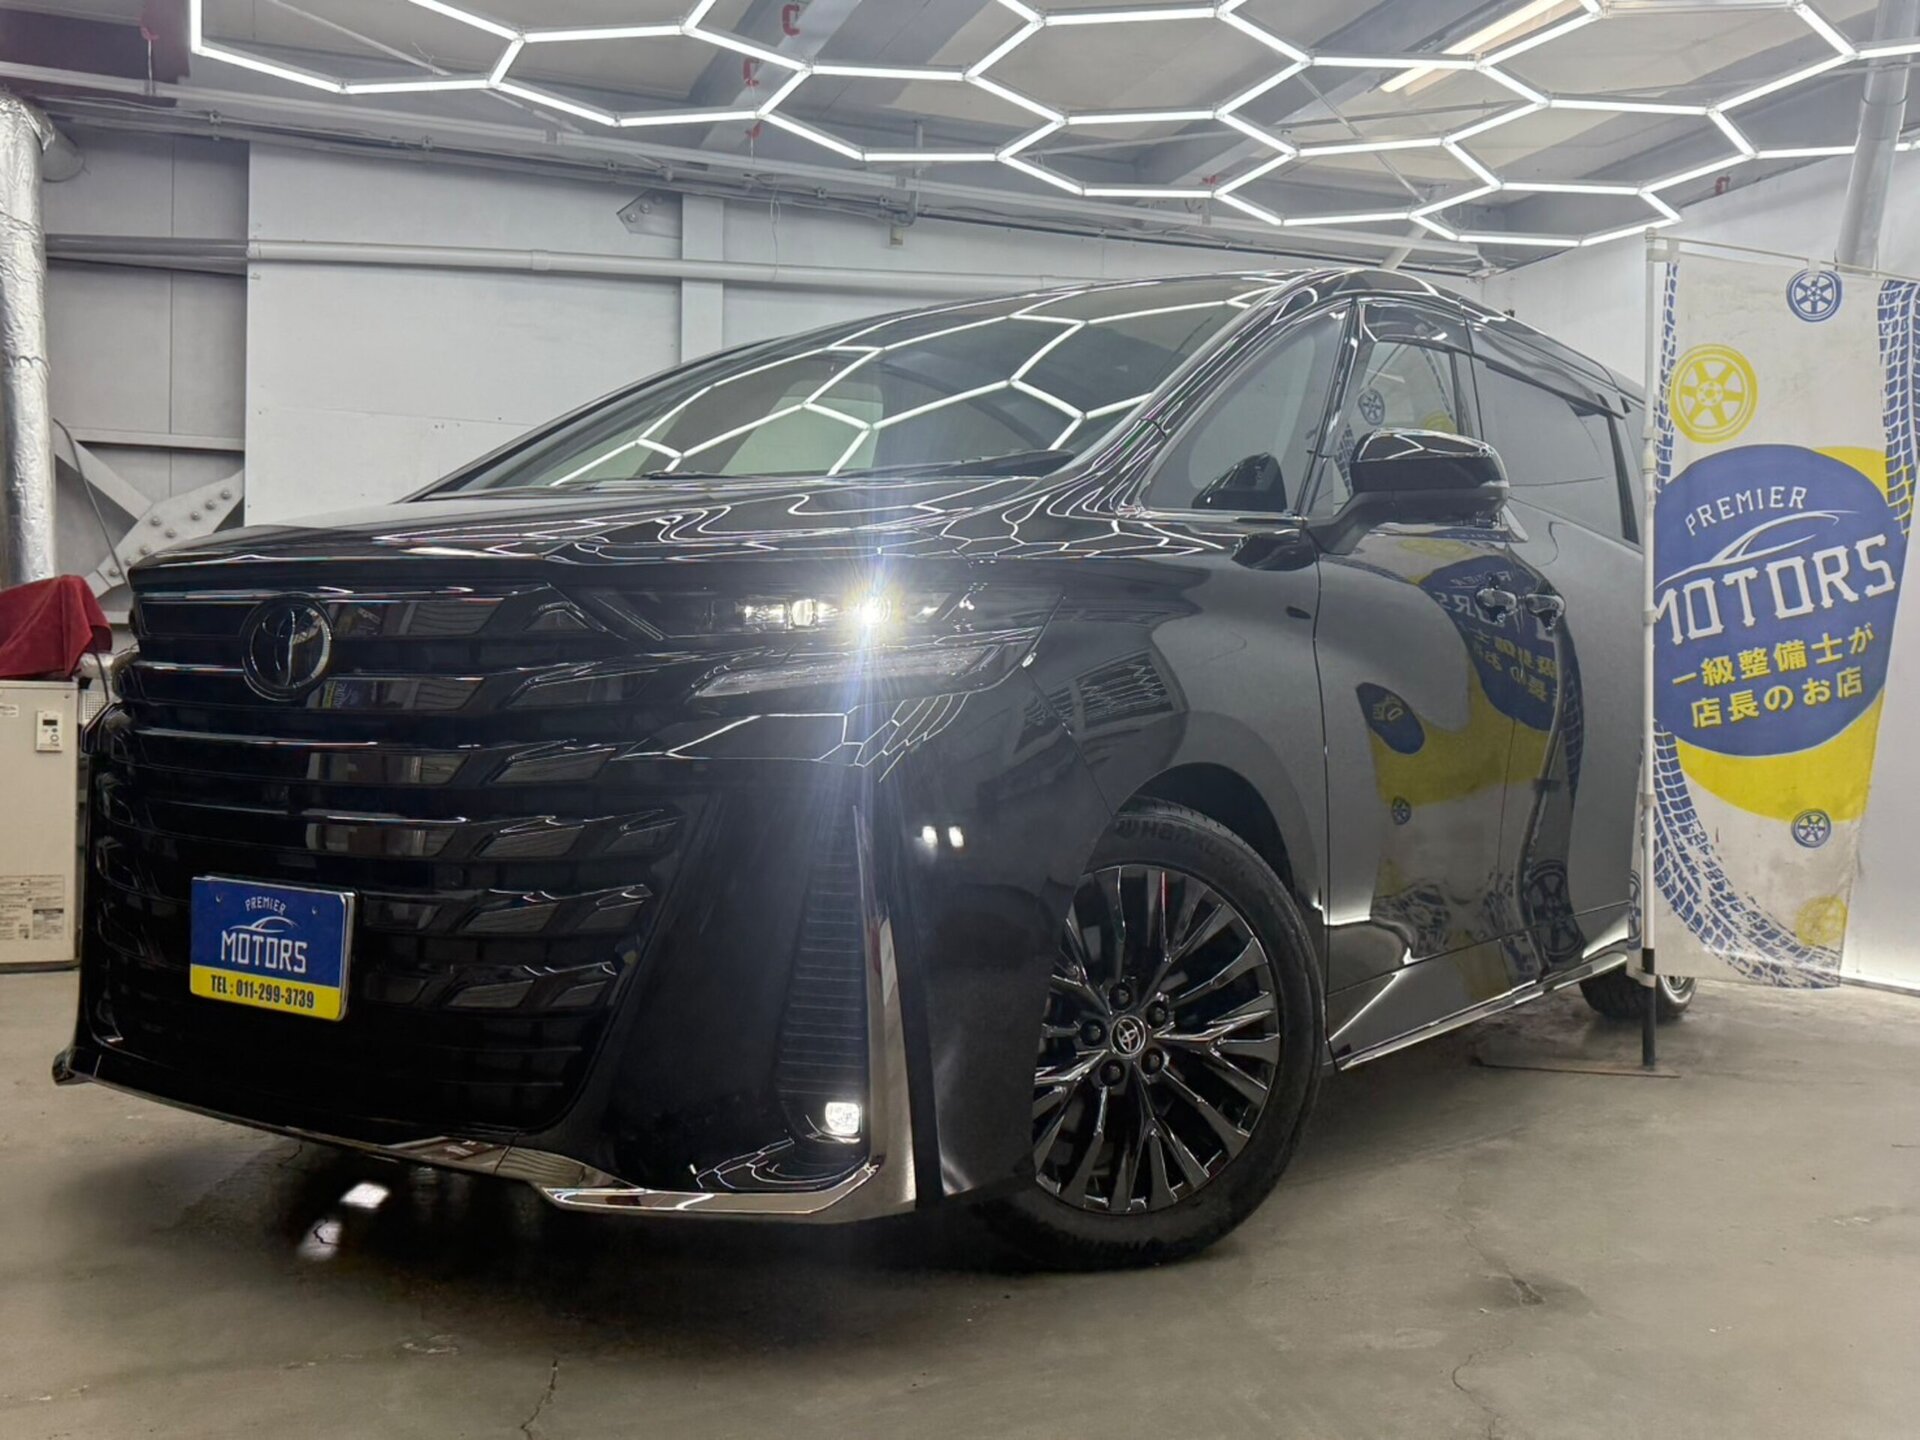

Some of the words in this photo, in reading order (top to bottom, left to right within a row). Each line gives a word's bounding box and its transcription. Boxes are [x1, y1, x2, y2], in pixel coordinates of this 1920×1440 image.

[1684, 486, 1807, 536] PREMIER
[1672, 622, 1874, 687] 一級整備士が
[1691, 666, 1863, 728] 店長のお店
[245, 896, 287, 916] PREMIER
[221, 930, 308, 974] MOTORS
[236, 979, 315, 1009] 011-299-3739
